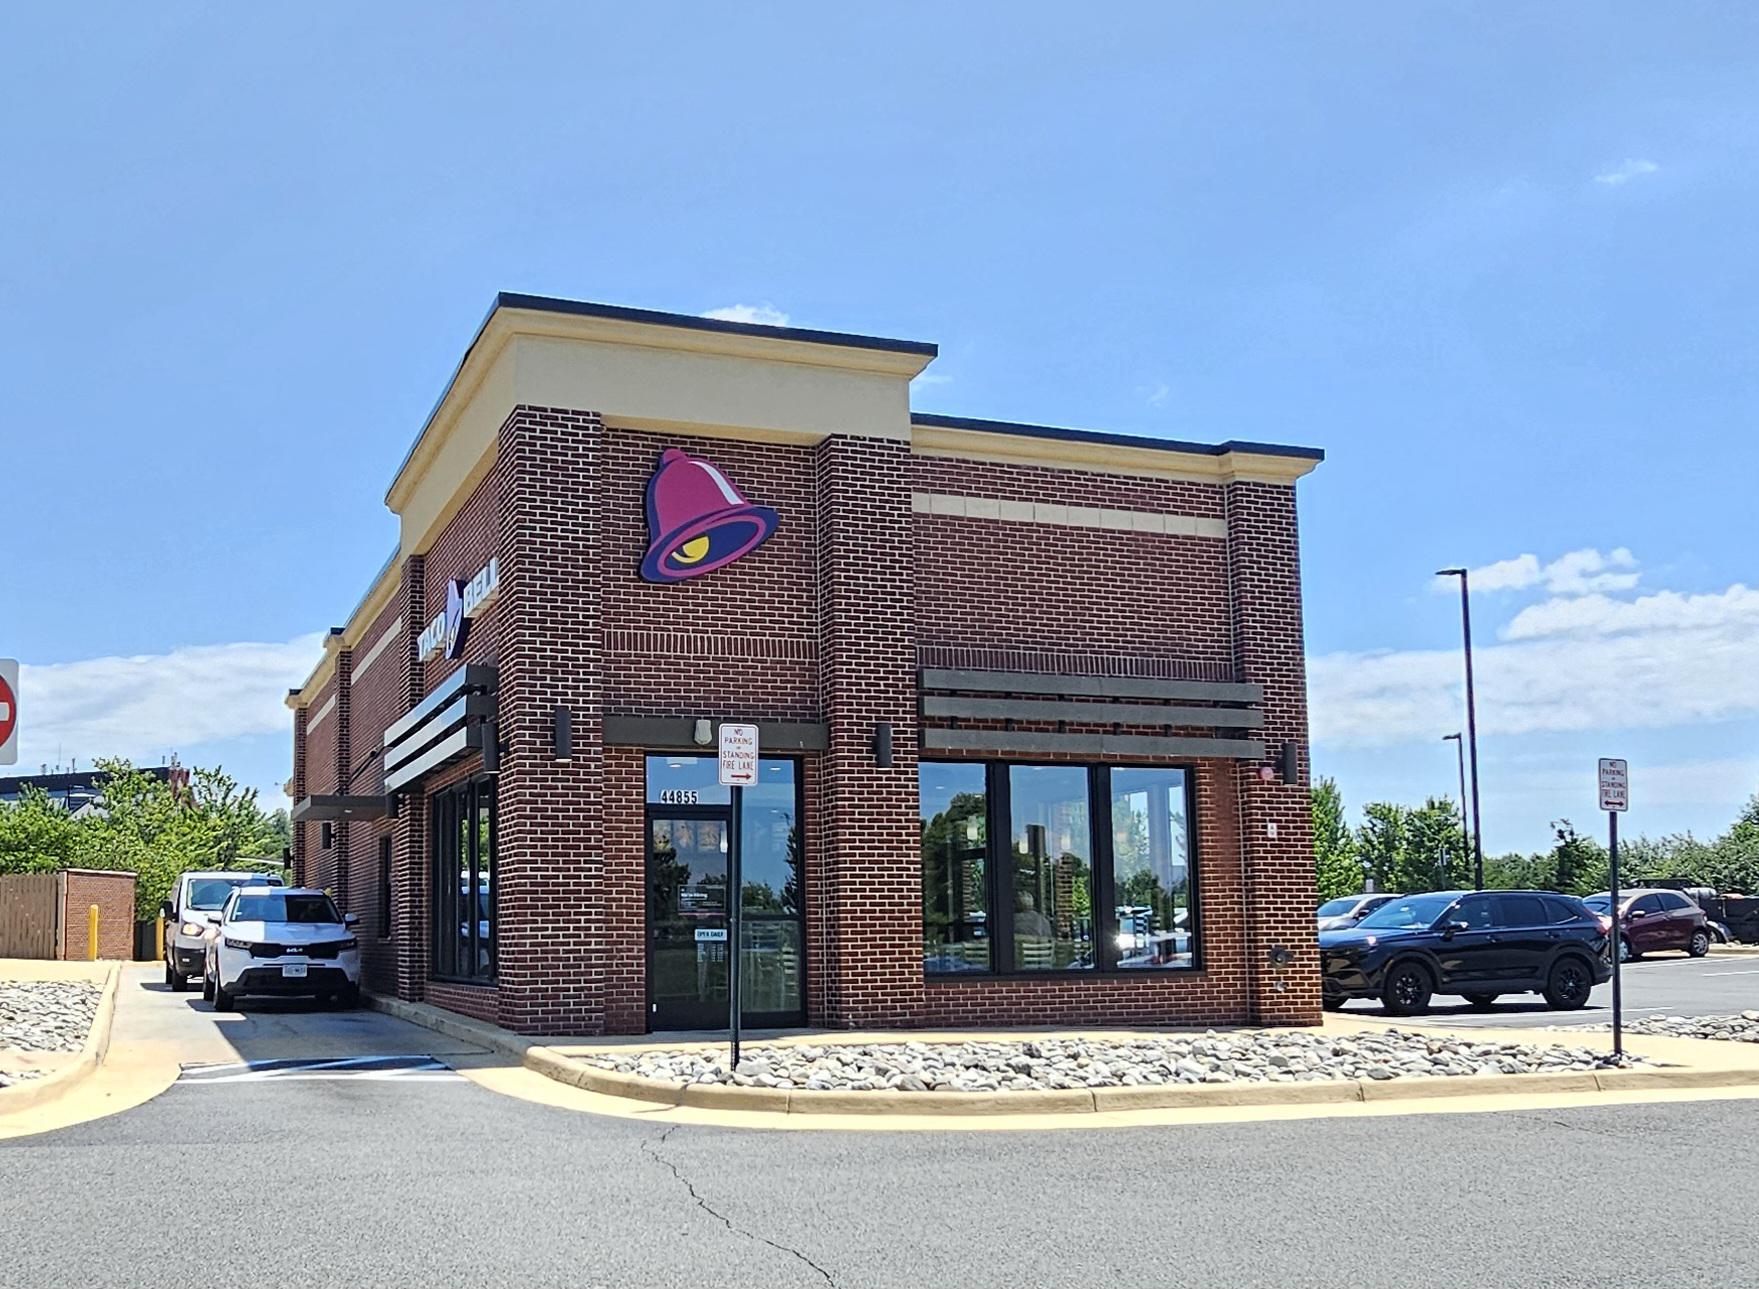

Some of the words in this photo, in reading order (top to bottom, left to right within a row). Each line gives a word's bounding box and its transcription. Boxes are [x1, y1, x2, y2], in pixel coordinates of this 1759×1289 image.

[417, 611, 446, 661] TACO
[464, 556, 500, 618] BELL
[734, 728, 743, 737] NO
[724, 737, 753, 746] PARKING
[722, 750, 754, 760] STANDING
[722, 760, 735, 770] FIRE
[738, 760, 754, 771] LANE
[661, 790, 698, 804] 44855
